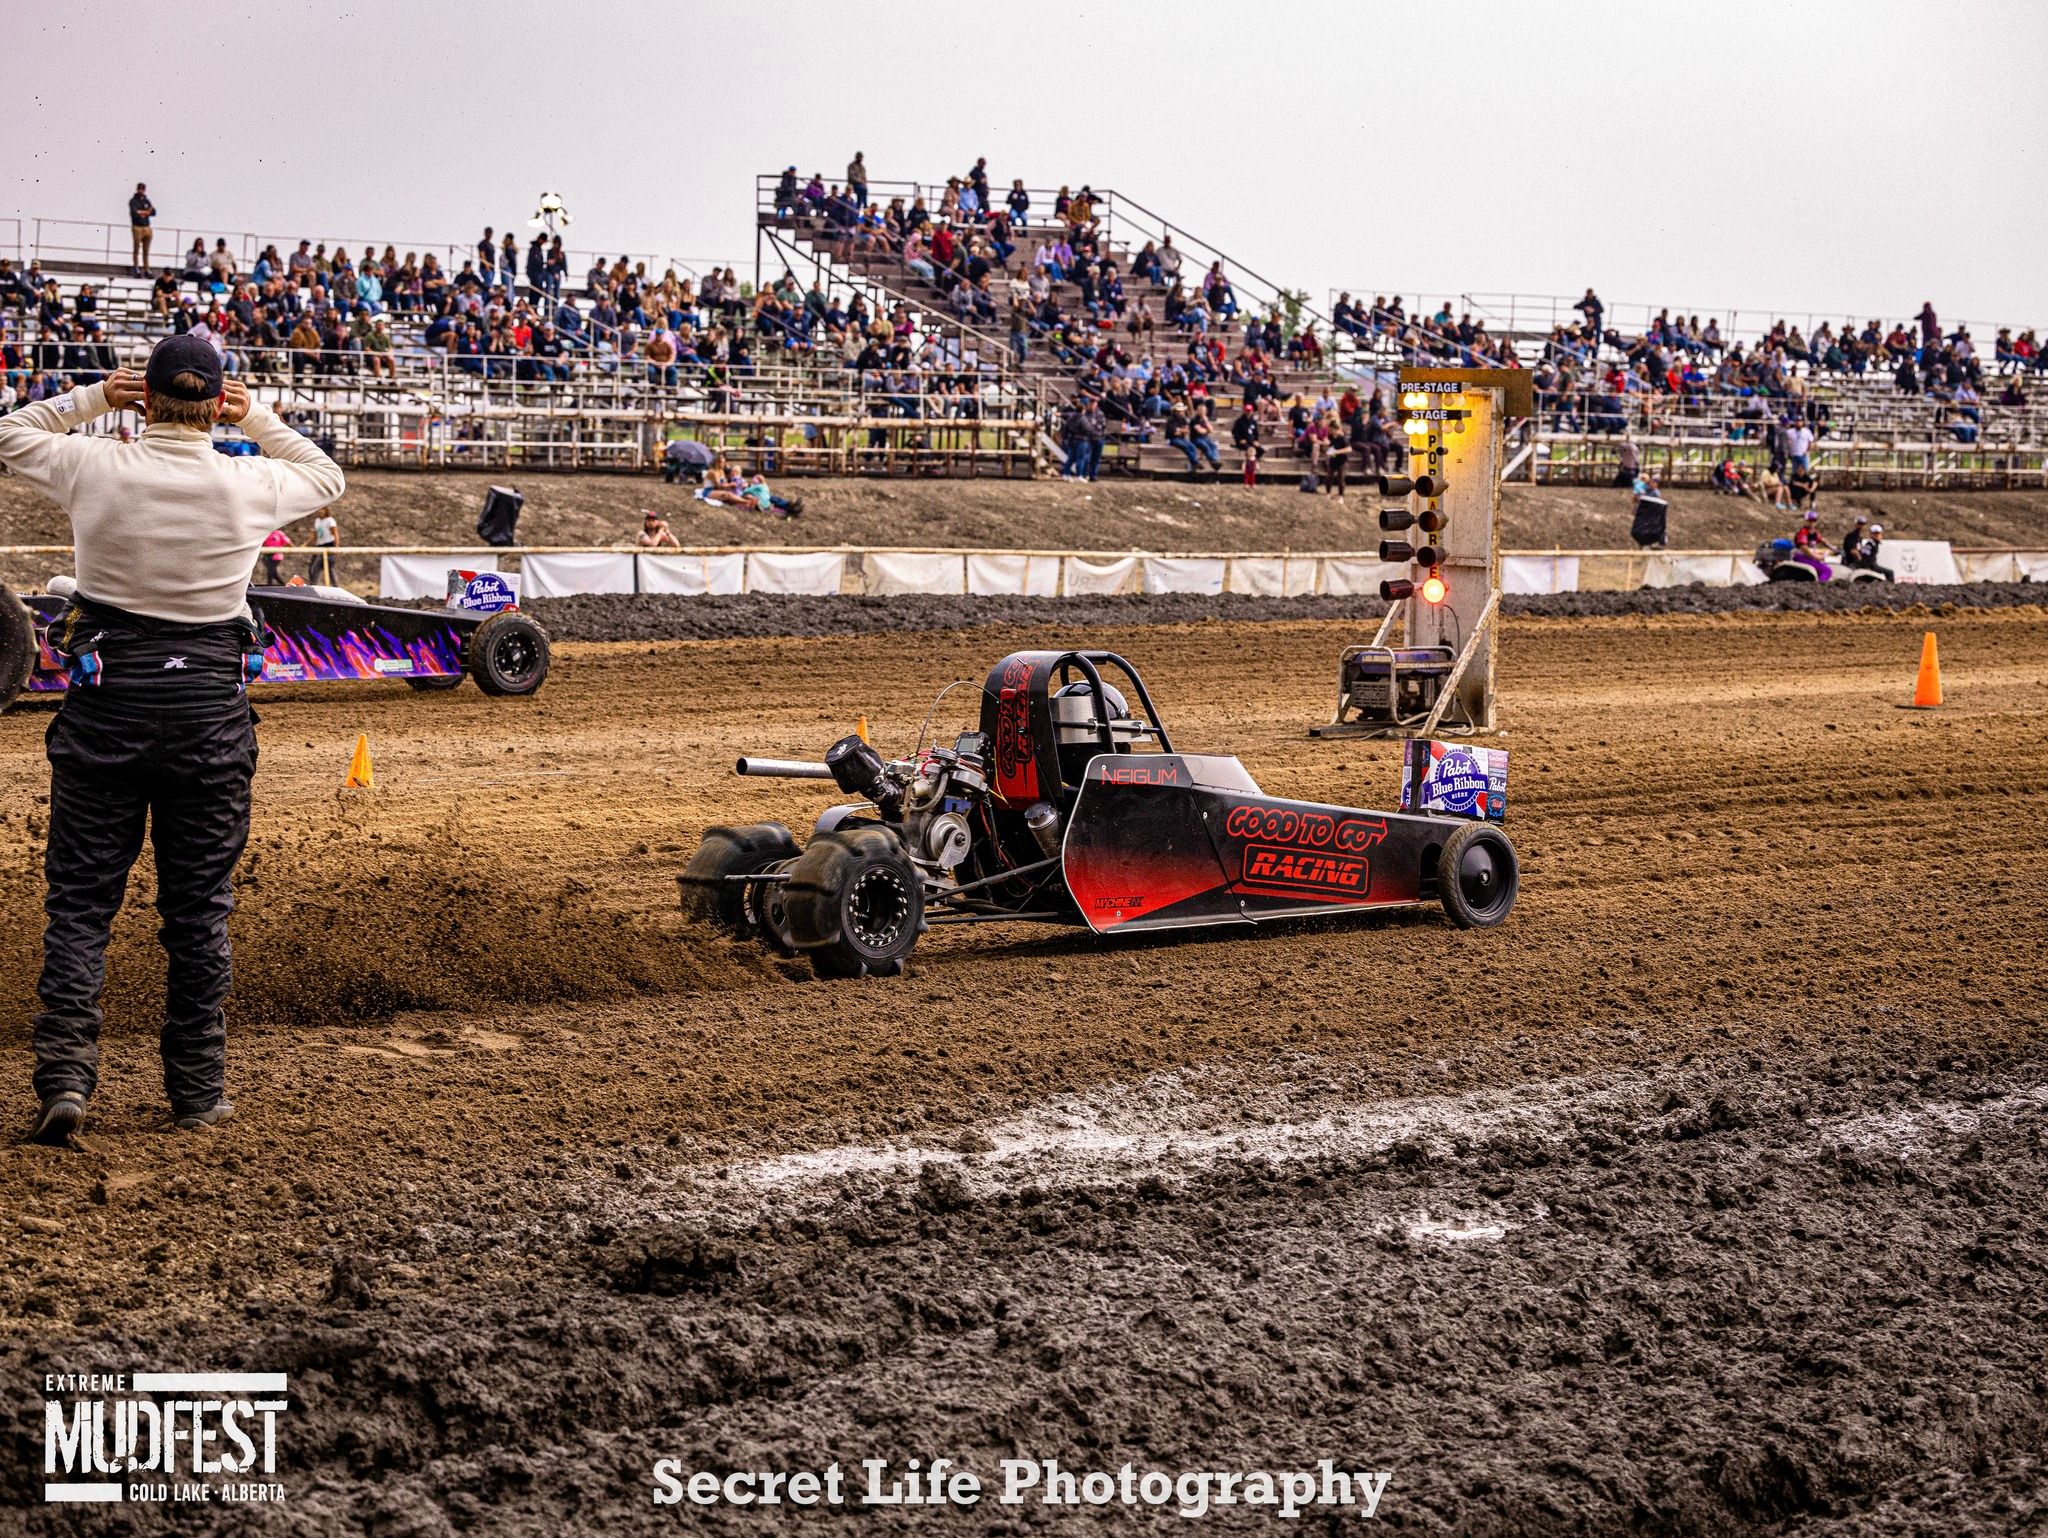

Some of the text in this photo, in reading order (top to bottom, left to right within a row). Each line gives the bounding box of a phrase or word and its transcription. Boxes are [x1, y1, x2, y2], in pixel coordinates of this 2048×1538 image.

[1400, 382, 1458, 392] PRE-STAGE
[1411, 410, 1448, 420] STAGE
[471, 580, 500, 595] Pabst
[463, 592, 512, 609] Blue Ribbon
[1101, 768, 1177, 785] NEIGUM
[1441, 758, 1472, 778] Pabst
[1432, 776, 1486, 798] Blue Ribbon
[1488, 777, 1507, 792] Pabst
[1451, 791, 1469, 799] BIÈRE
[1226, 805, 1382, 851] GOOD TO GO
[1249, 852, 1363, 886] RACING
